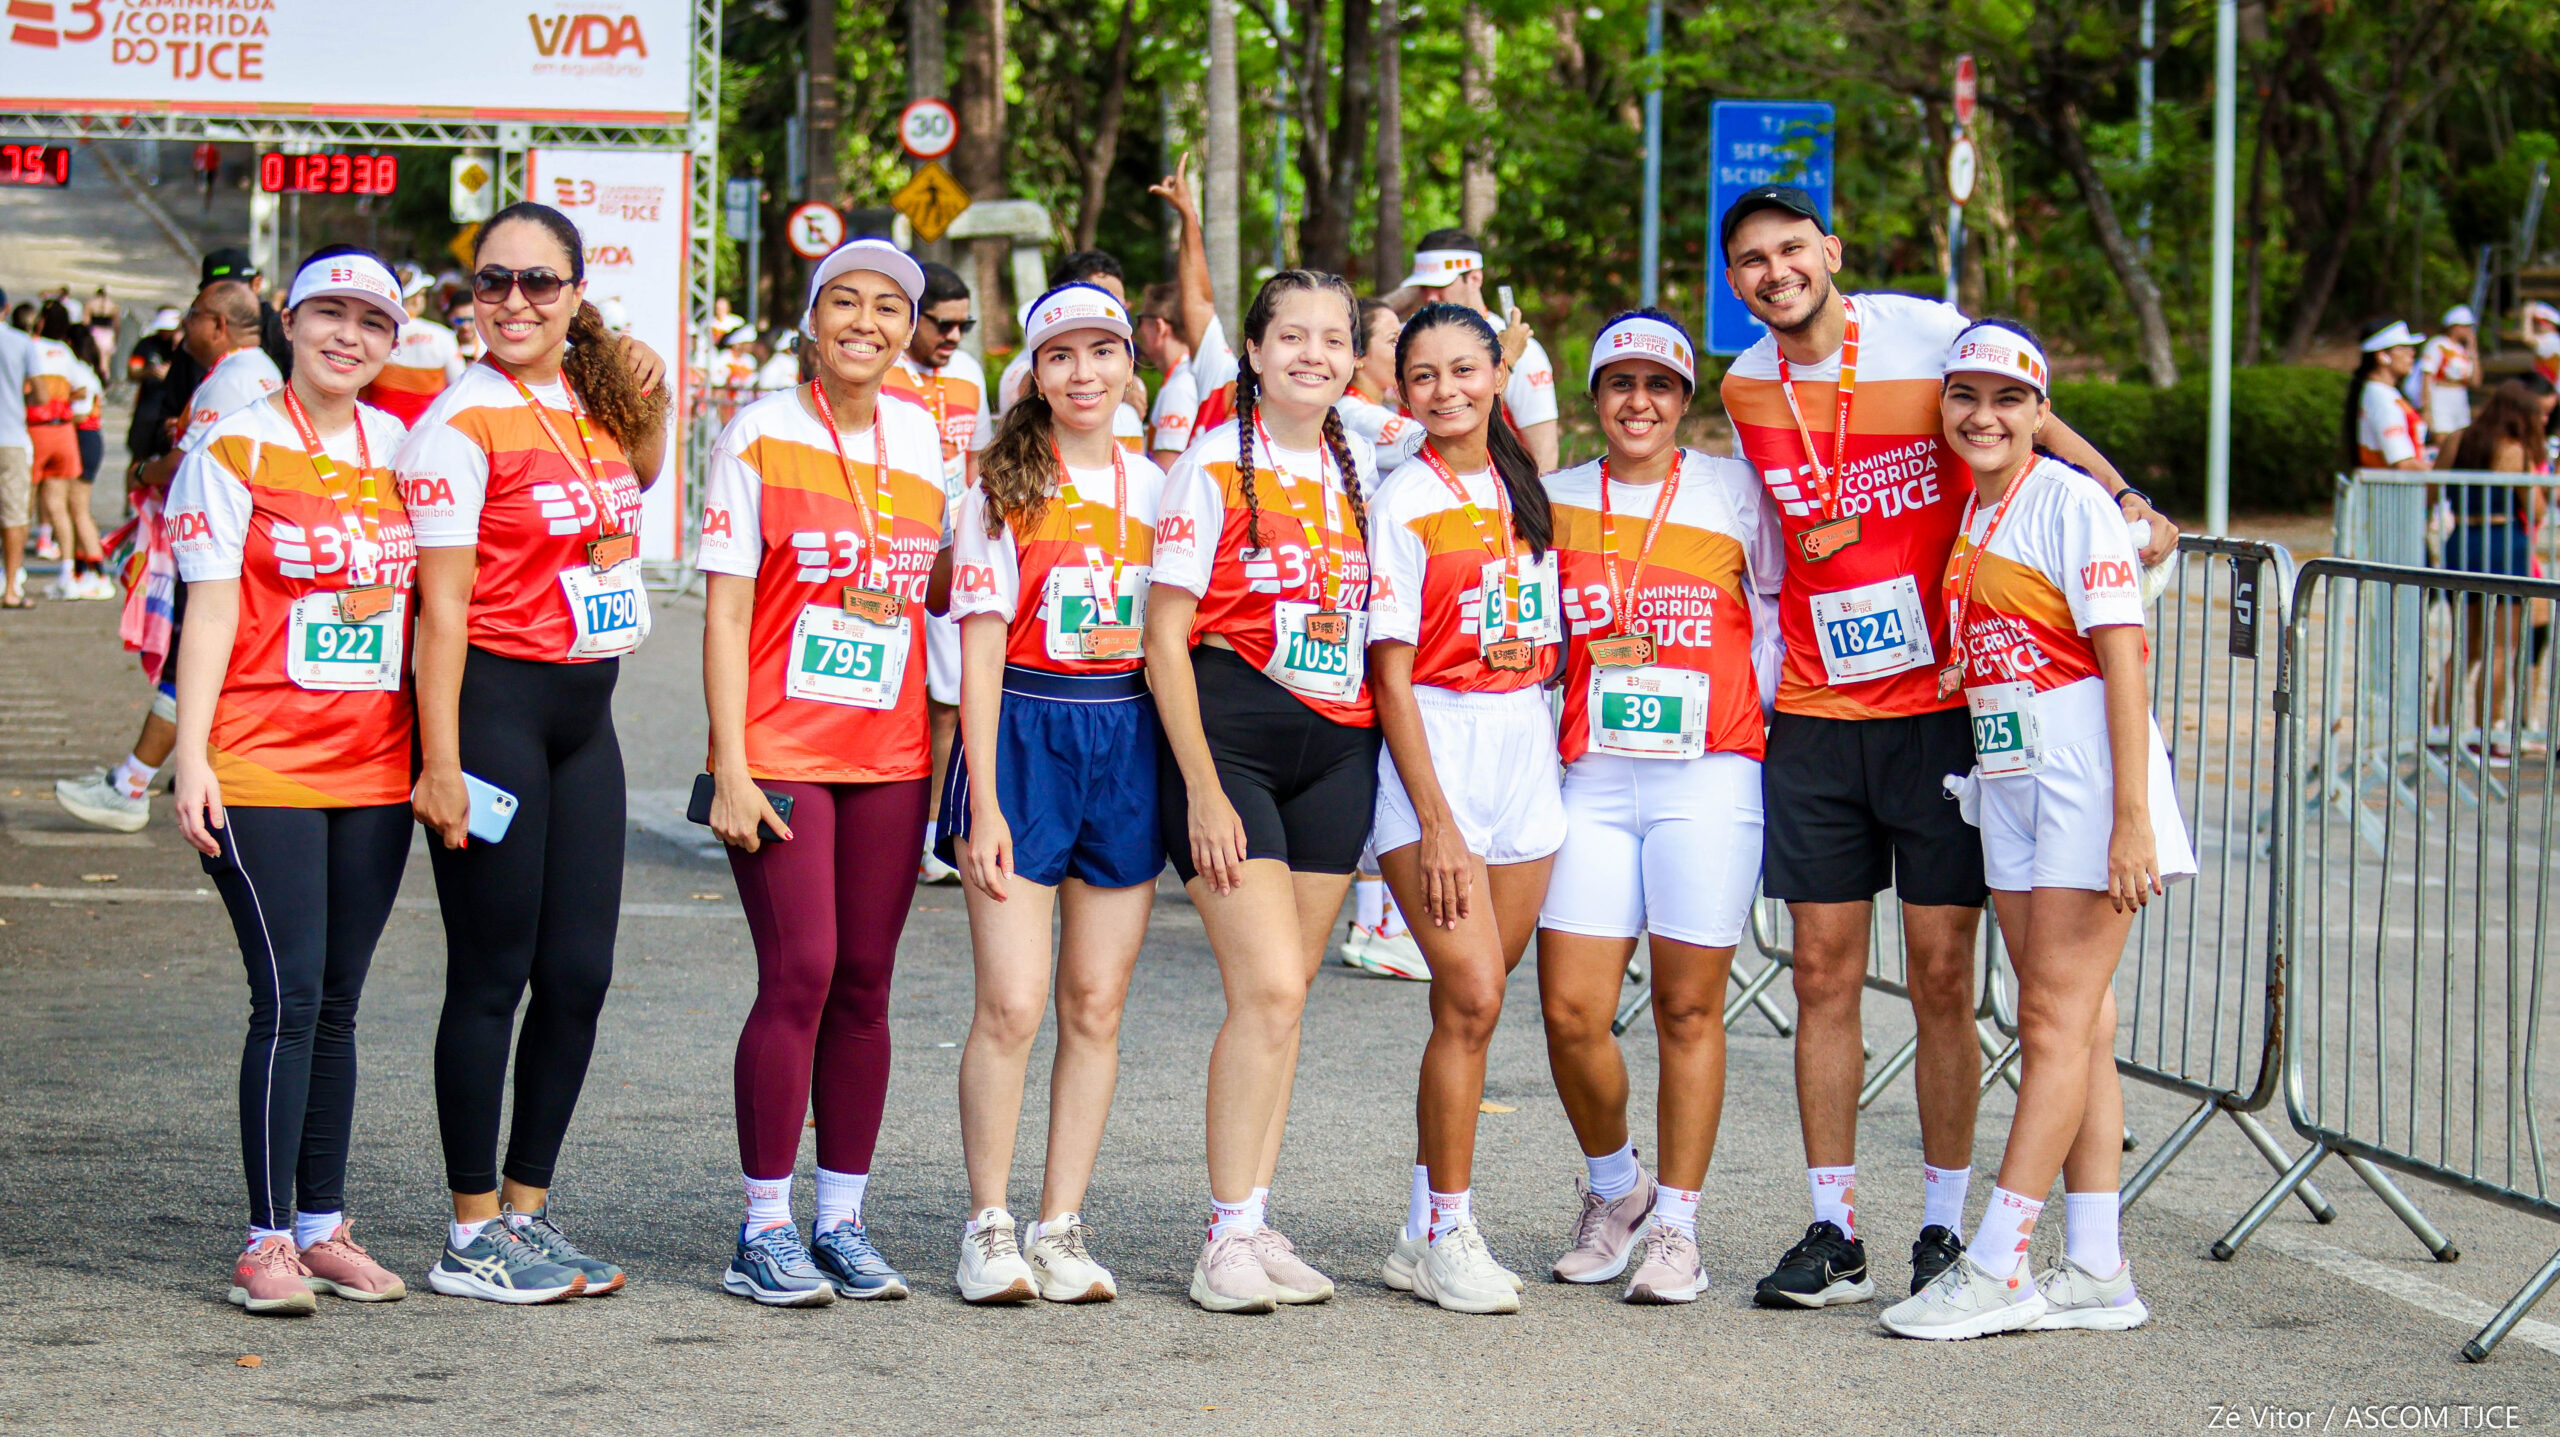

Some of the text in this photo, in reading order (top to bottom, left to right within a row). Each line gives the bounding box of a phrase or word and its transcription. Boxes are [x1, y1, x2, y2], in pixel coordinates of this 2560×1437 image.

[528, 13, 648, 58] VIDA
[112, 38, 264, 80] DO TJCE
[910, 113, 948, 137] 30
[621, 204, 660, 221] TJCE
[1645, 343, 1667, 355] TJCE
[1987, 353, 2009, 366] TJCE
[1438, 466, 1450, 481] TJCE
[1841, 438, 1938, 477] CAMINHADA
[1840, 472, 1941, 519] DO TJCE
[164, 511, 213, 543] VIDA
[1156, 515, 1195, 548] VIDA
[2080, 561, 2136, 590] VIDA
[587, 591, 636, 630] 1790
[1816, 609, 1825, 627] 5KM
[317, 625, 375, 661] 922
[1652, 619, 1712, 647] TJCE
[1831, 612, 1903, 655] 1824
[816, 638, 872, 678] 795
[1292, 634, 1347, 674] 1035
[1988, 642, 2052, 681] TJCE
[1593, 678, 1601, 696] 3KM
[1622, 696, 1662, 730] 39
[1976, 715, 2013, 752] 925
[1033, 1254, 1049, 1269] FILA
